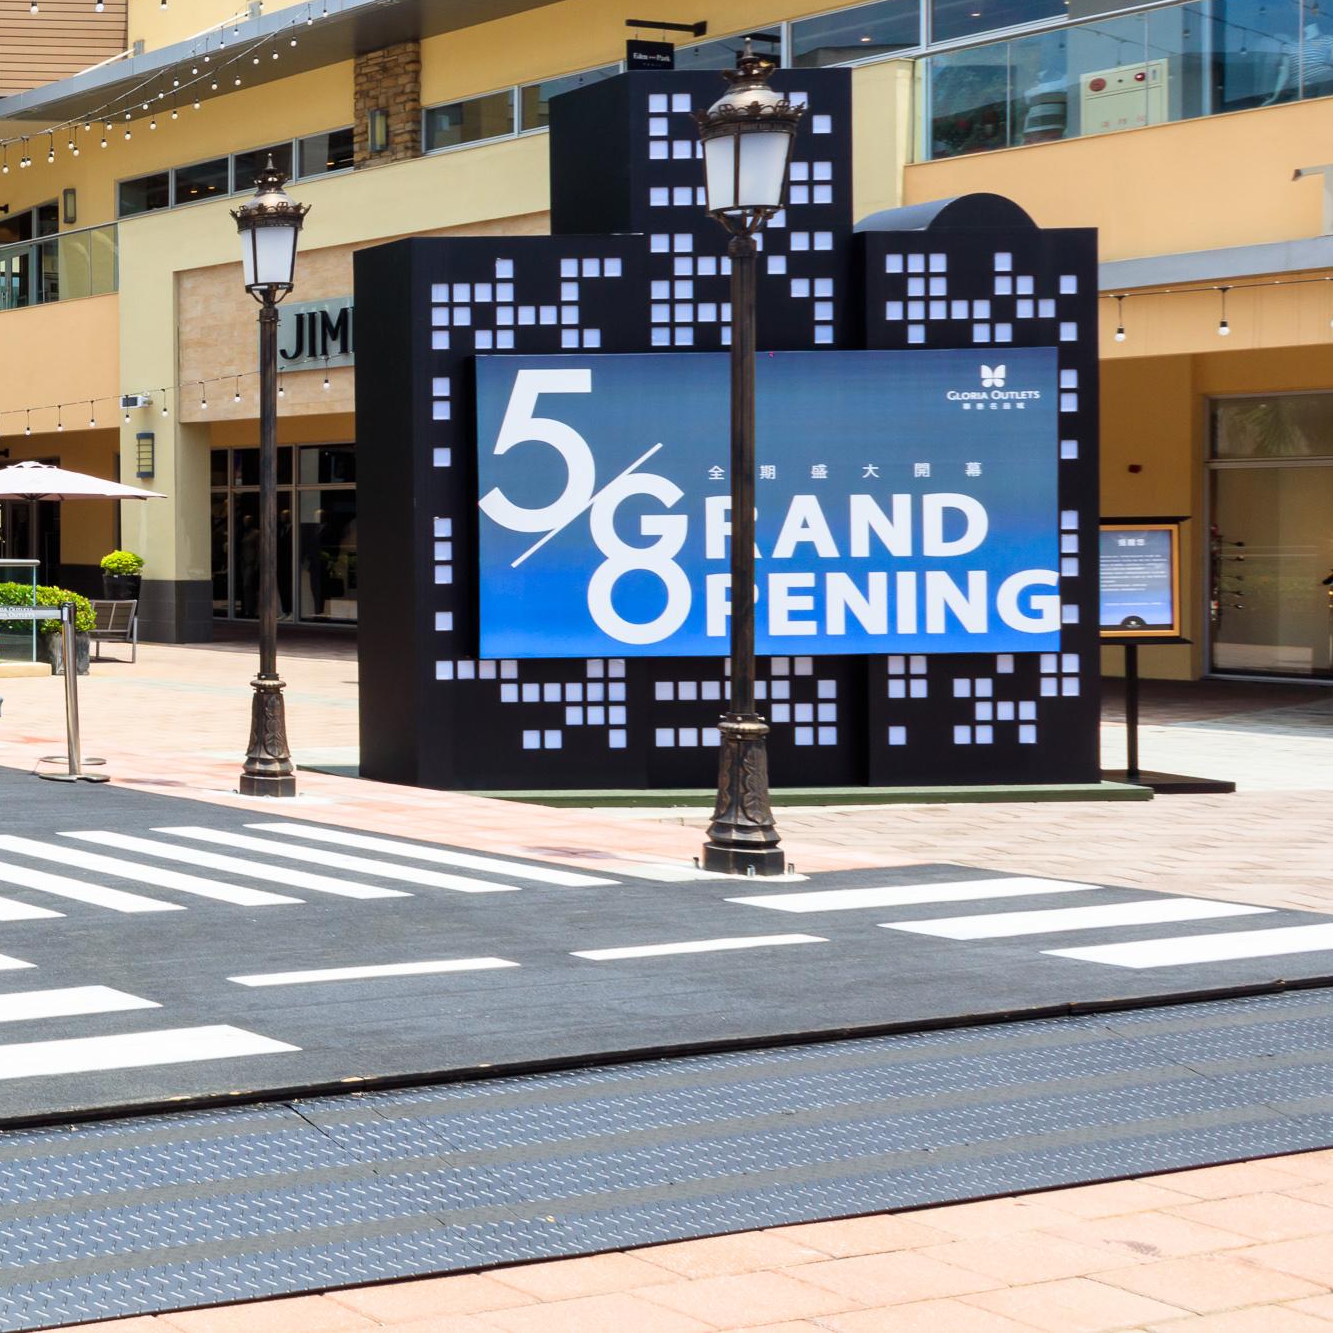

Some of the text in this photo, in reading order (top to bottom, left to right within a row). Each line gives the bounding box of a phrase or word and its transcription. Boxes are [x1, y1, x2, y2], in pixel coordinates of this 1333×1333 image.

[633, 52, 672, 63] Eden Park
[946, 390, 1042, 400] GLORIA OUTLETS
[707, 461, 983, 481] 全期盛大開幕
